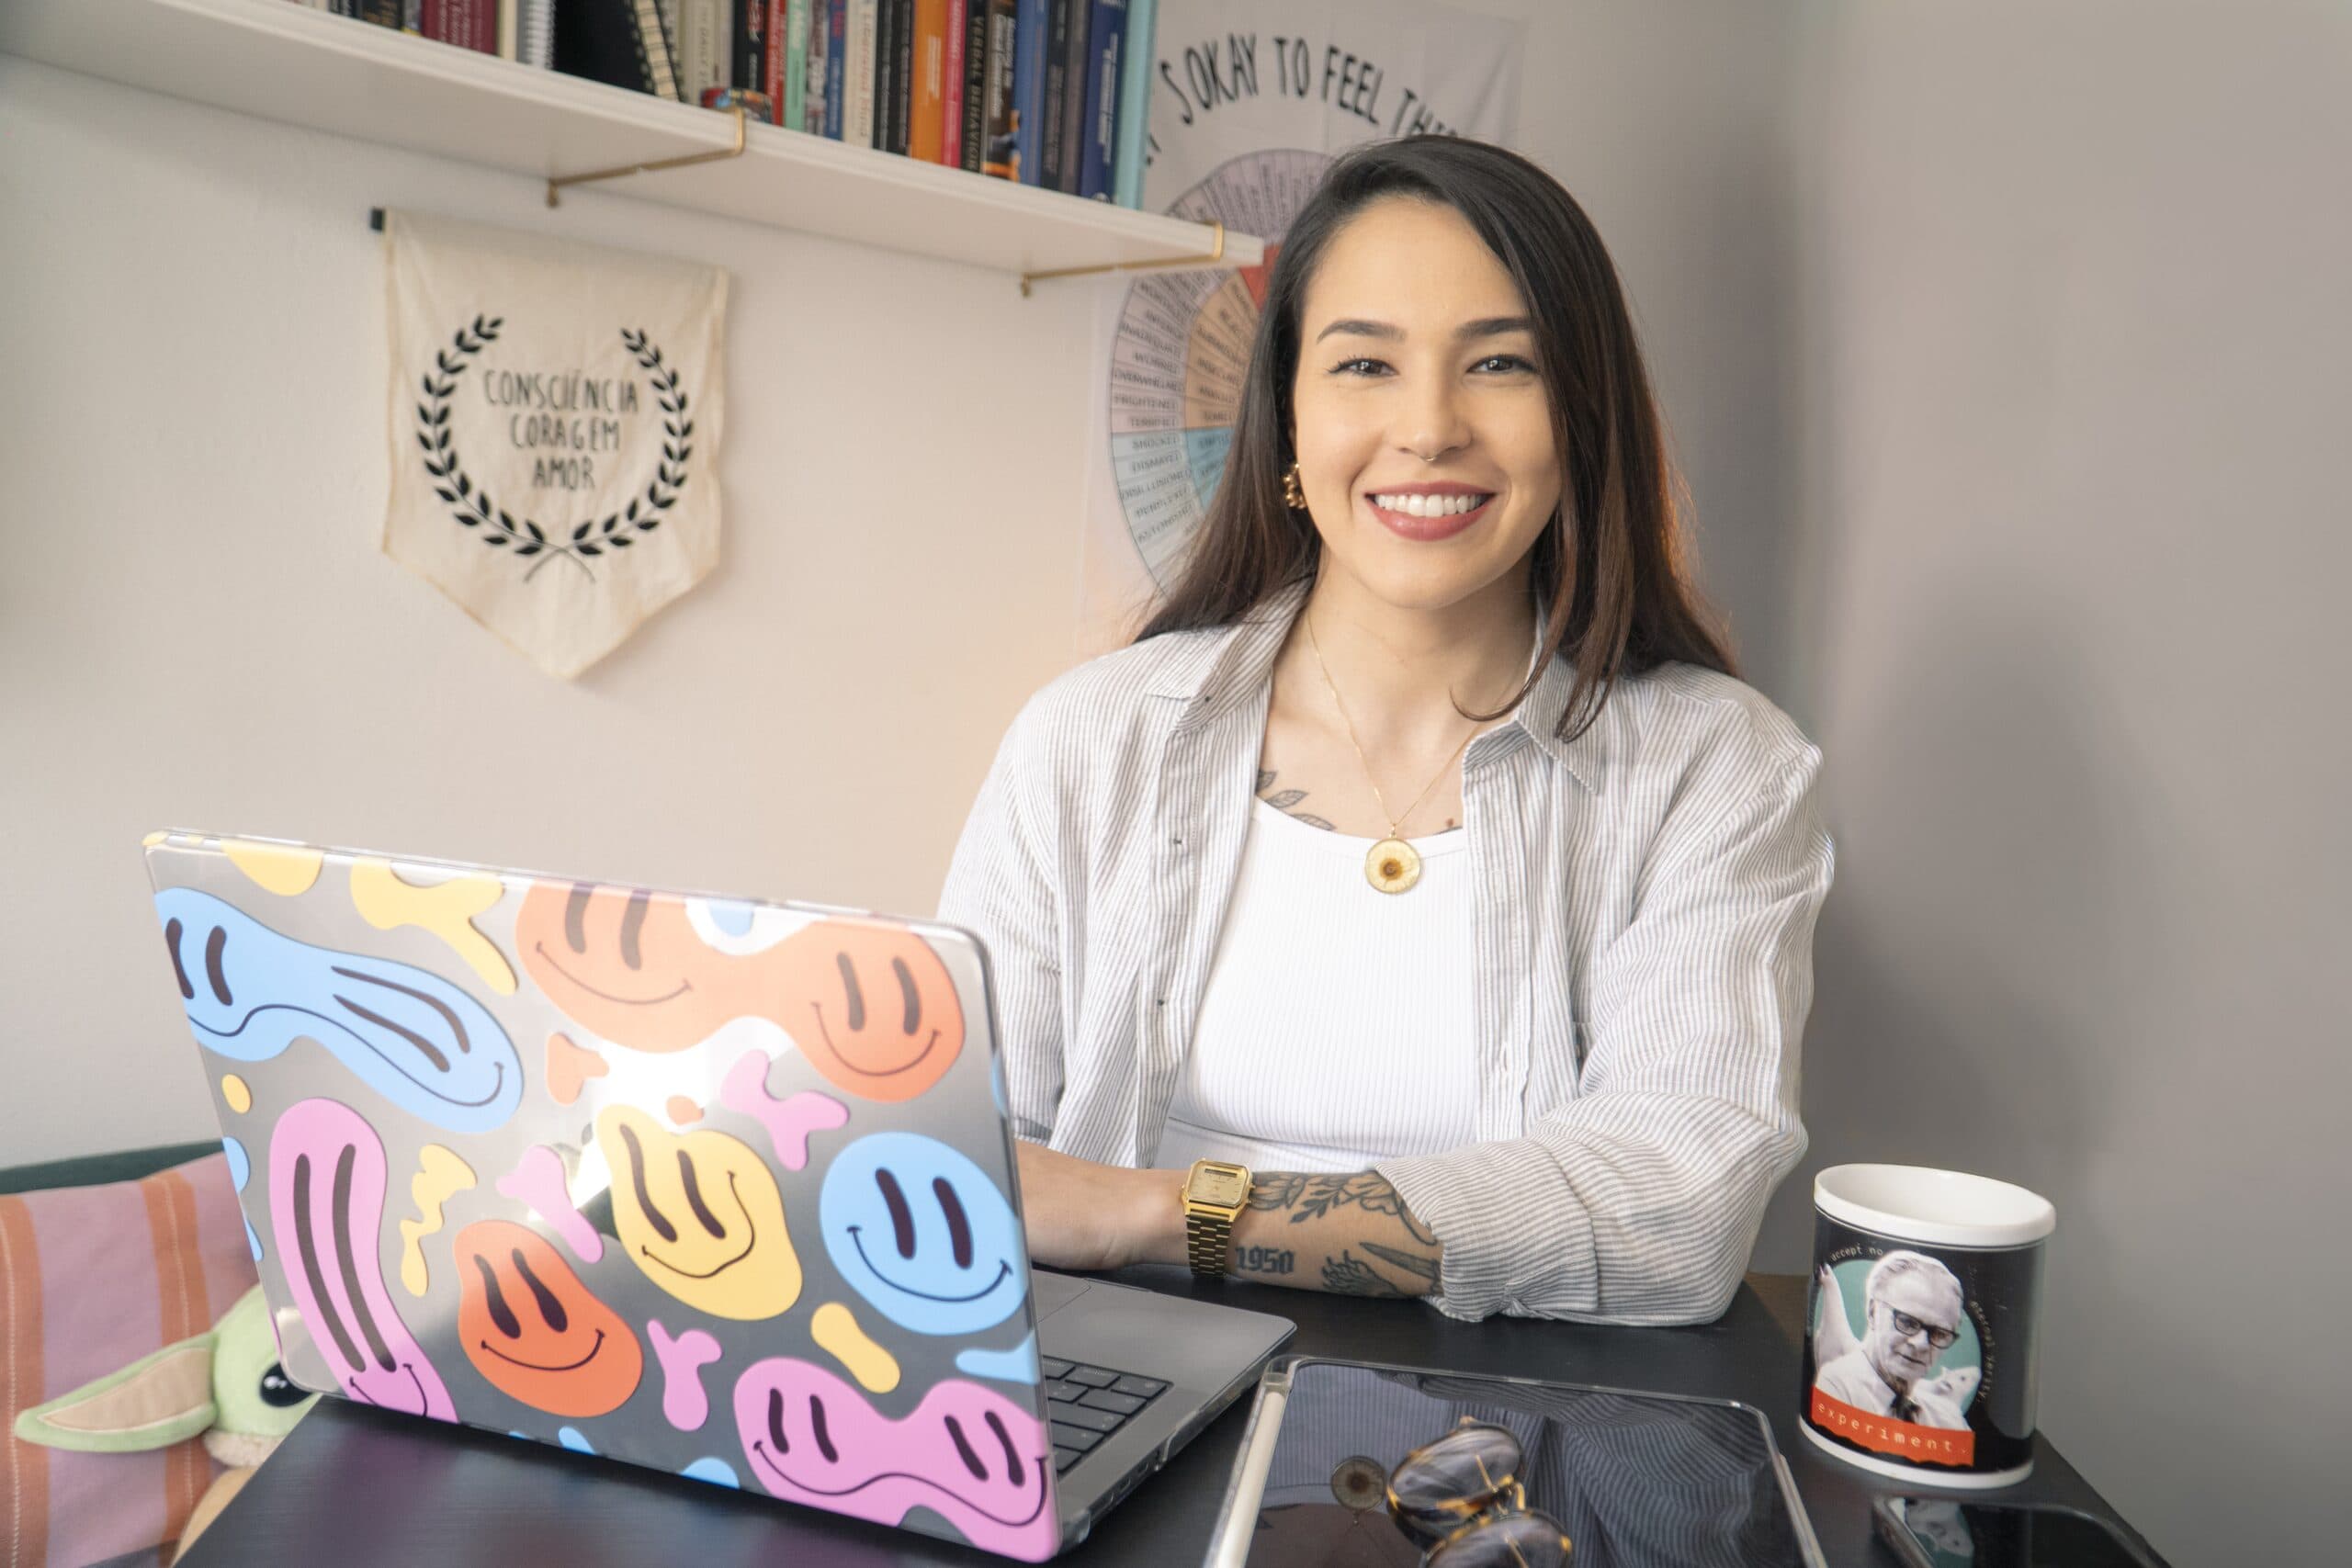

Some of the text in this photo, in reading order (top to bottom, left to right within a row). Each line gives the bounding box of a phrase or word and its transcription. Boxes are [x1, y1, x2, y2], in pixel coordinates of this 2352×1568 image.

[969, 15, 985, 81] VERBAL
[1183, 31, 1259, 111] OKAY
[1273, 36, 1311, 98] TO
[1320, 44, 1385, 127] FEEL
[510, 412, 620, 451] CORAGEM
[532, 455, 596, 491] AMOR
[1235, 1246, 1295, 1275] 1950
[1868, 1247, 1883, 1257] no
